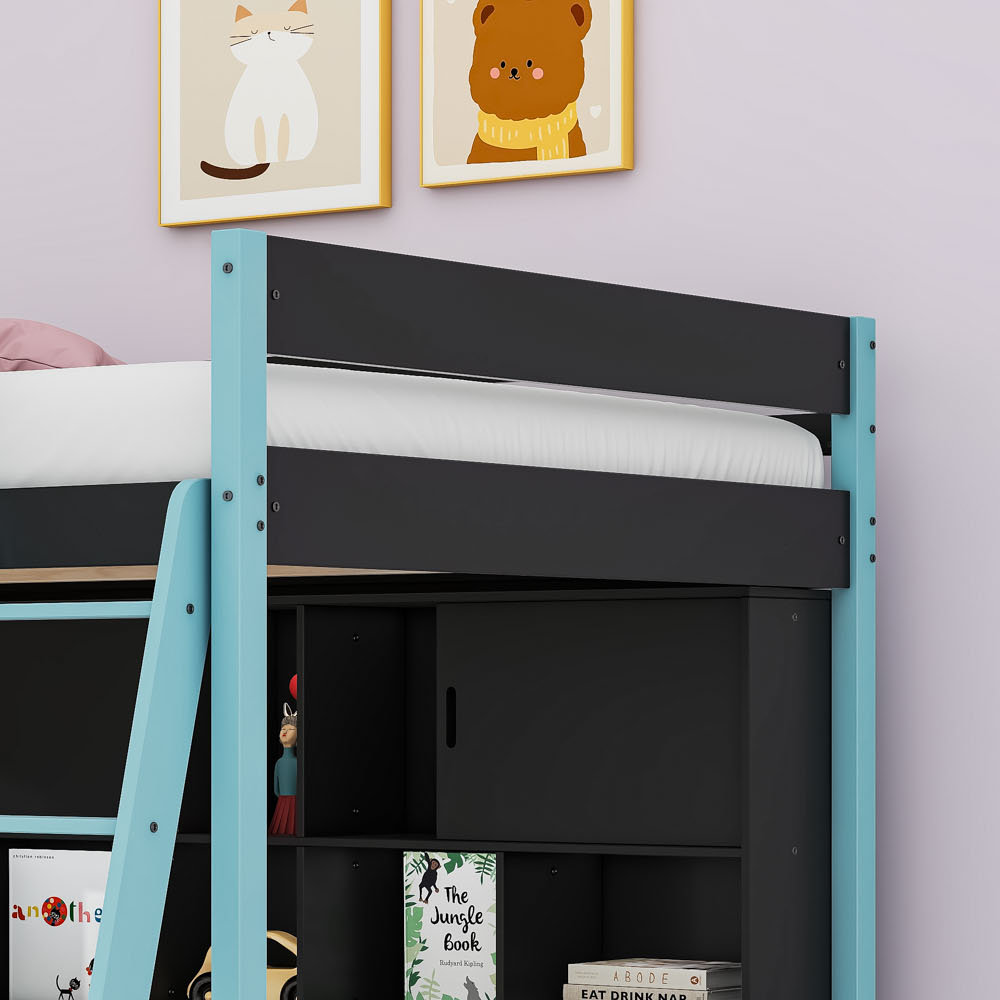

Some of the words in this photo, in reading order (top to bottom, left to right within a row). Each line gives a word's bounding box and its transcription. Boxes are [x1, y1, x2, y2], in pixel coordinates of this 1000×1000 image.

[444, 885, 468, 904] The
[430, 905, 484, 933] Jungle
[444, 931, 482, 952] Book
[463, 960, 484, 968] Kipling
[613, 970, 669, 984] ABODE
[581, 989, 607, 1000] EAT
